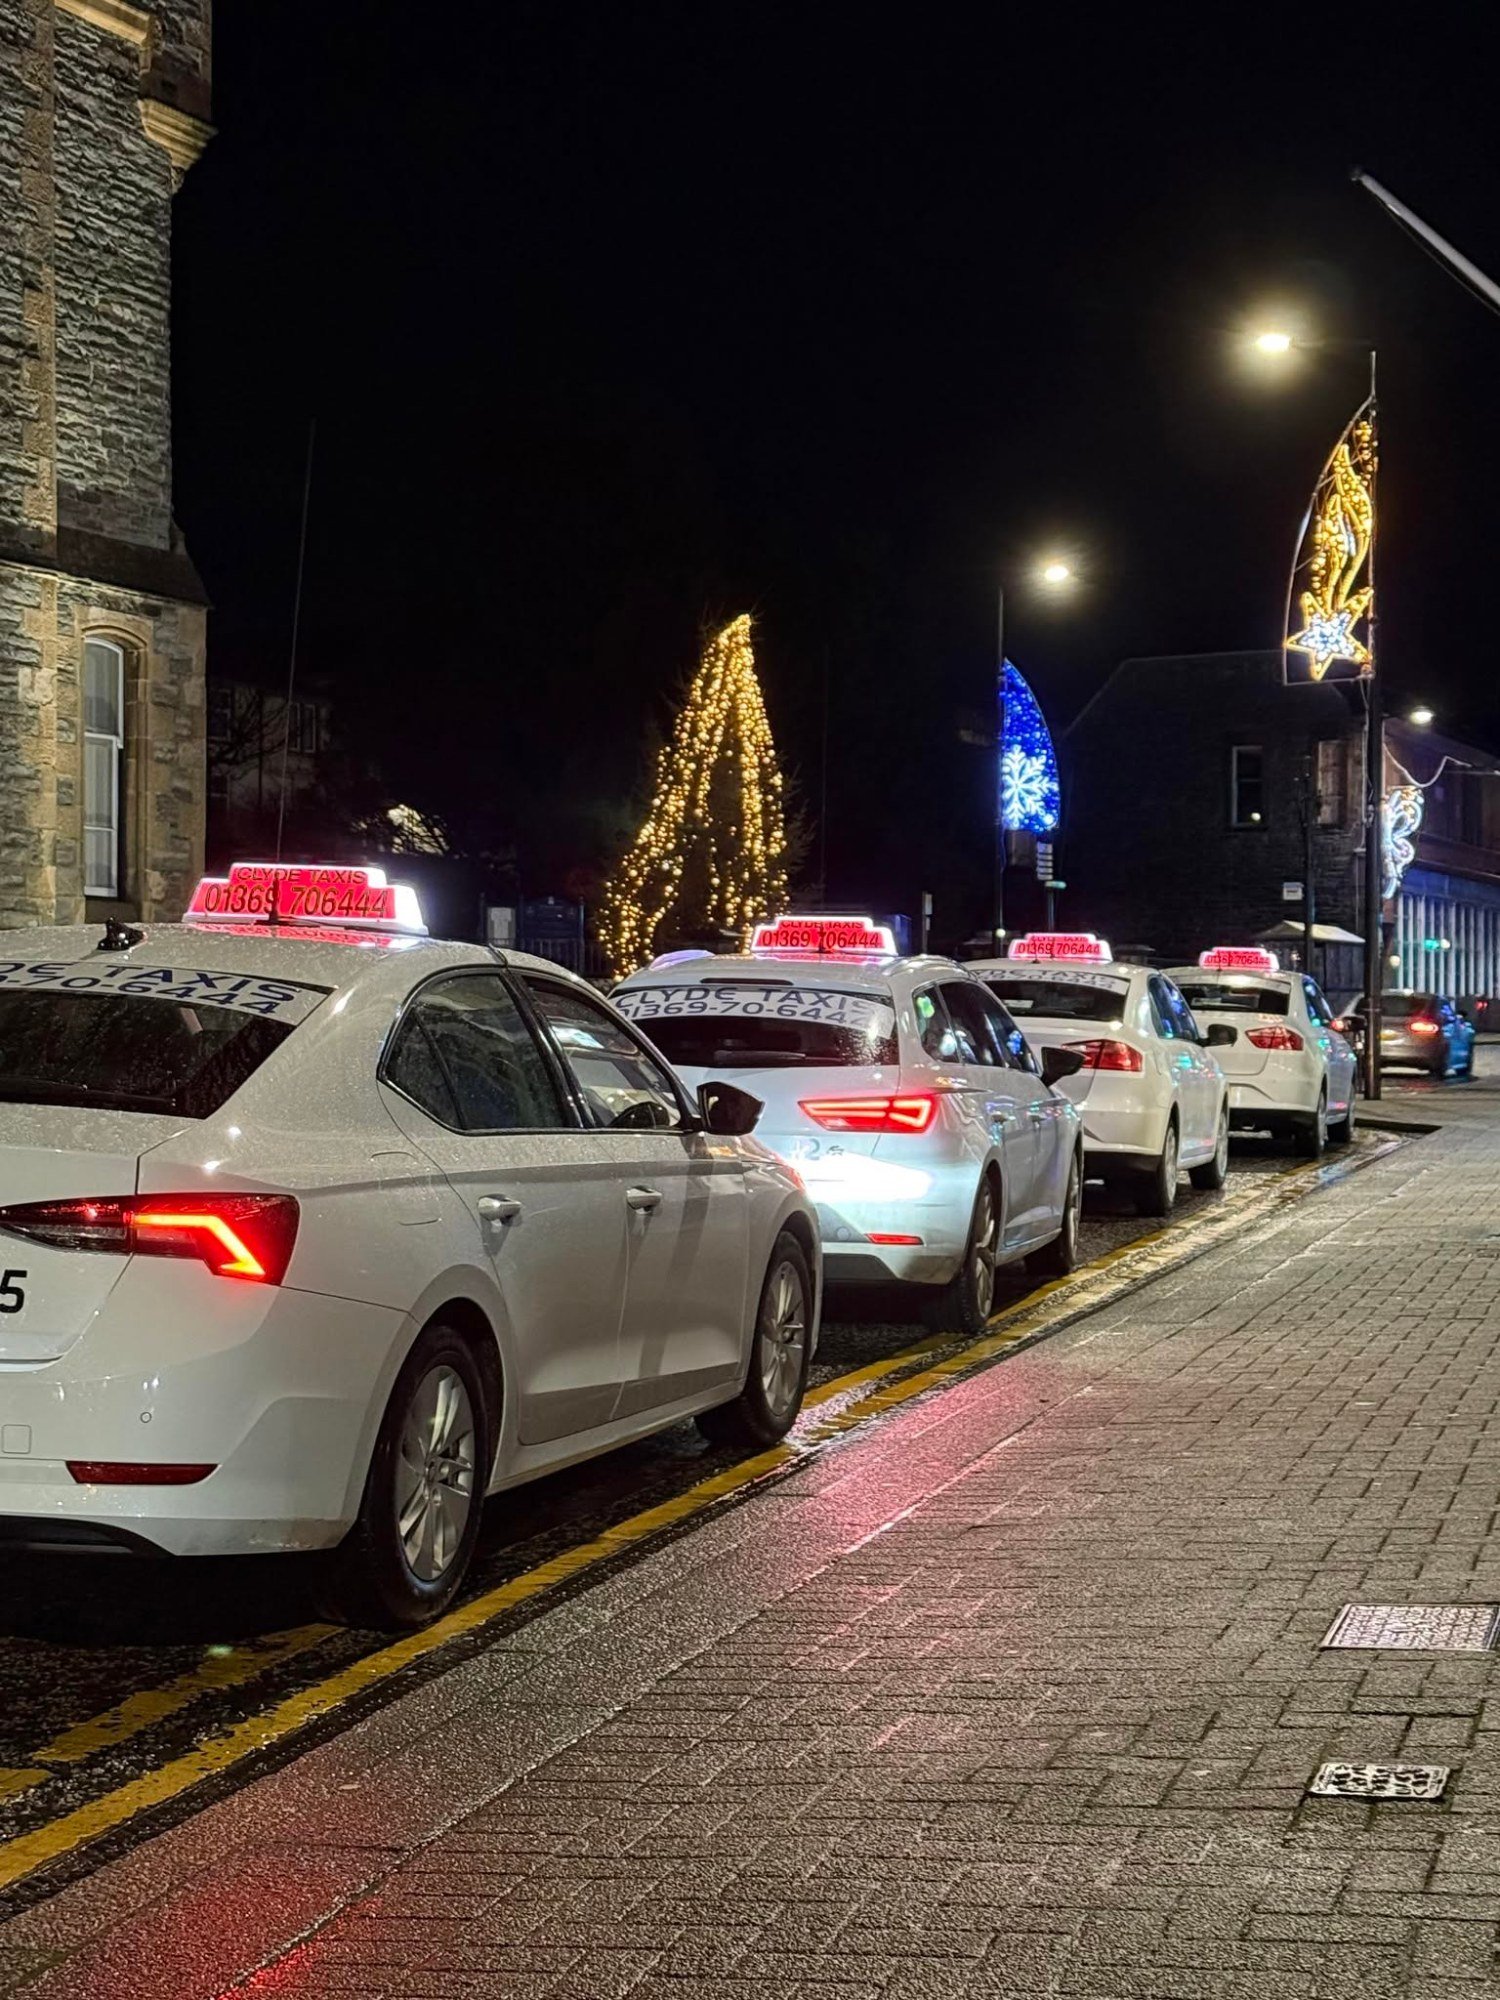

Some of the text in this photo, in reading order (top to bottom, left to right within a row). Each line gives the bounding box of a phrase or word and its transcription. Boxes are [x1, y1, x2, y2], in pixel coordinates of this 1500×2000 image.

[237, 866, 368, 885] CLYDE TAXIS
[204, 883, 388, 918] 01369 706444
[762, 930, 810, 948] 01369
[104, 964, 302, 1002] TAXIS
[616, 986, 873, 1014] CLYDE TAXIS
[0, 1269, 28, 1314] 5
